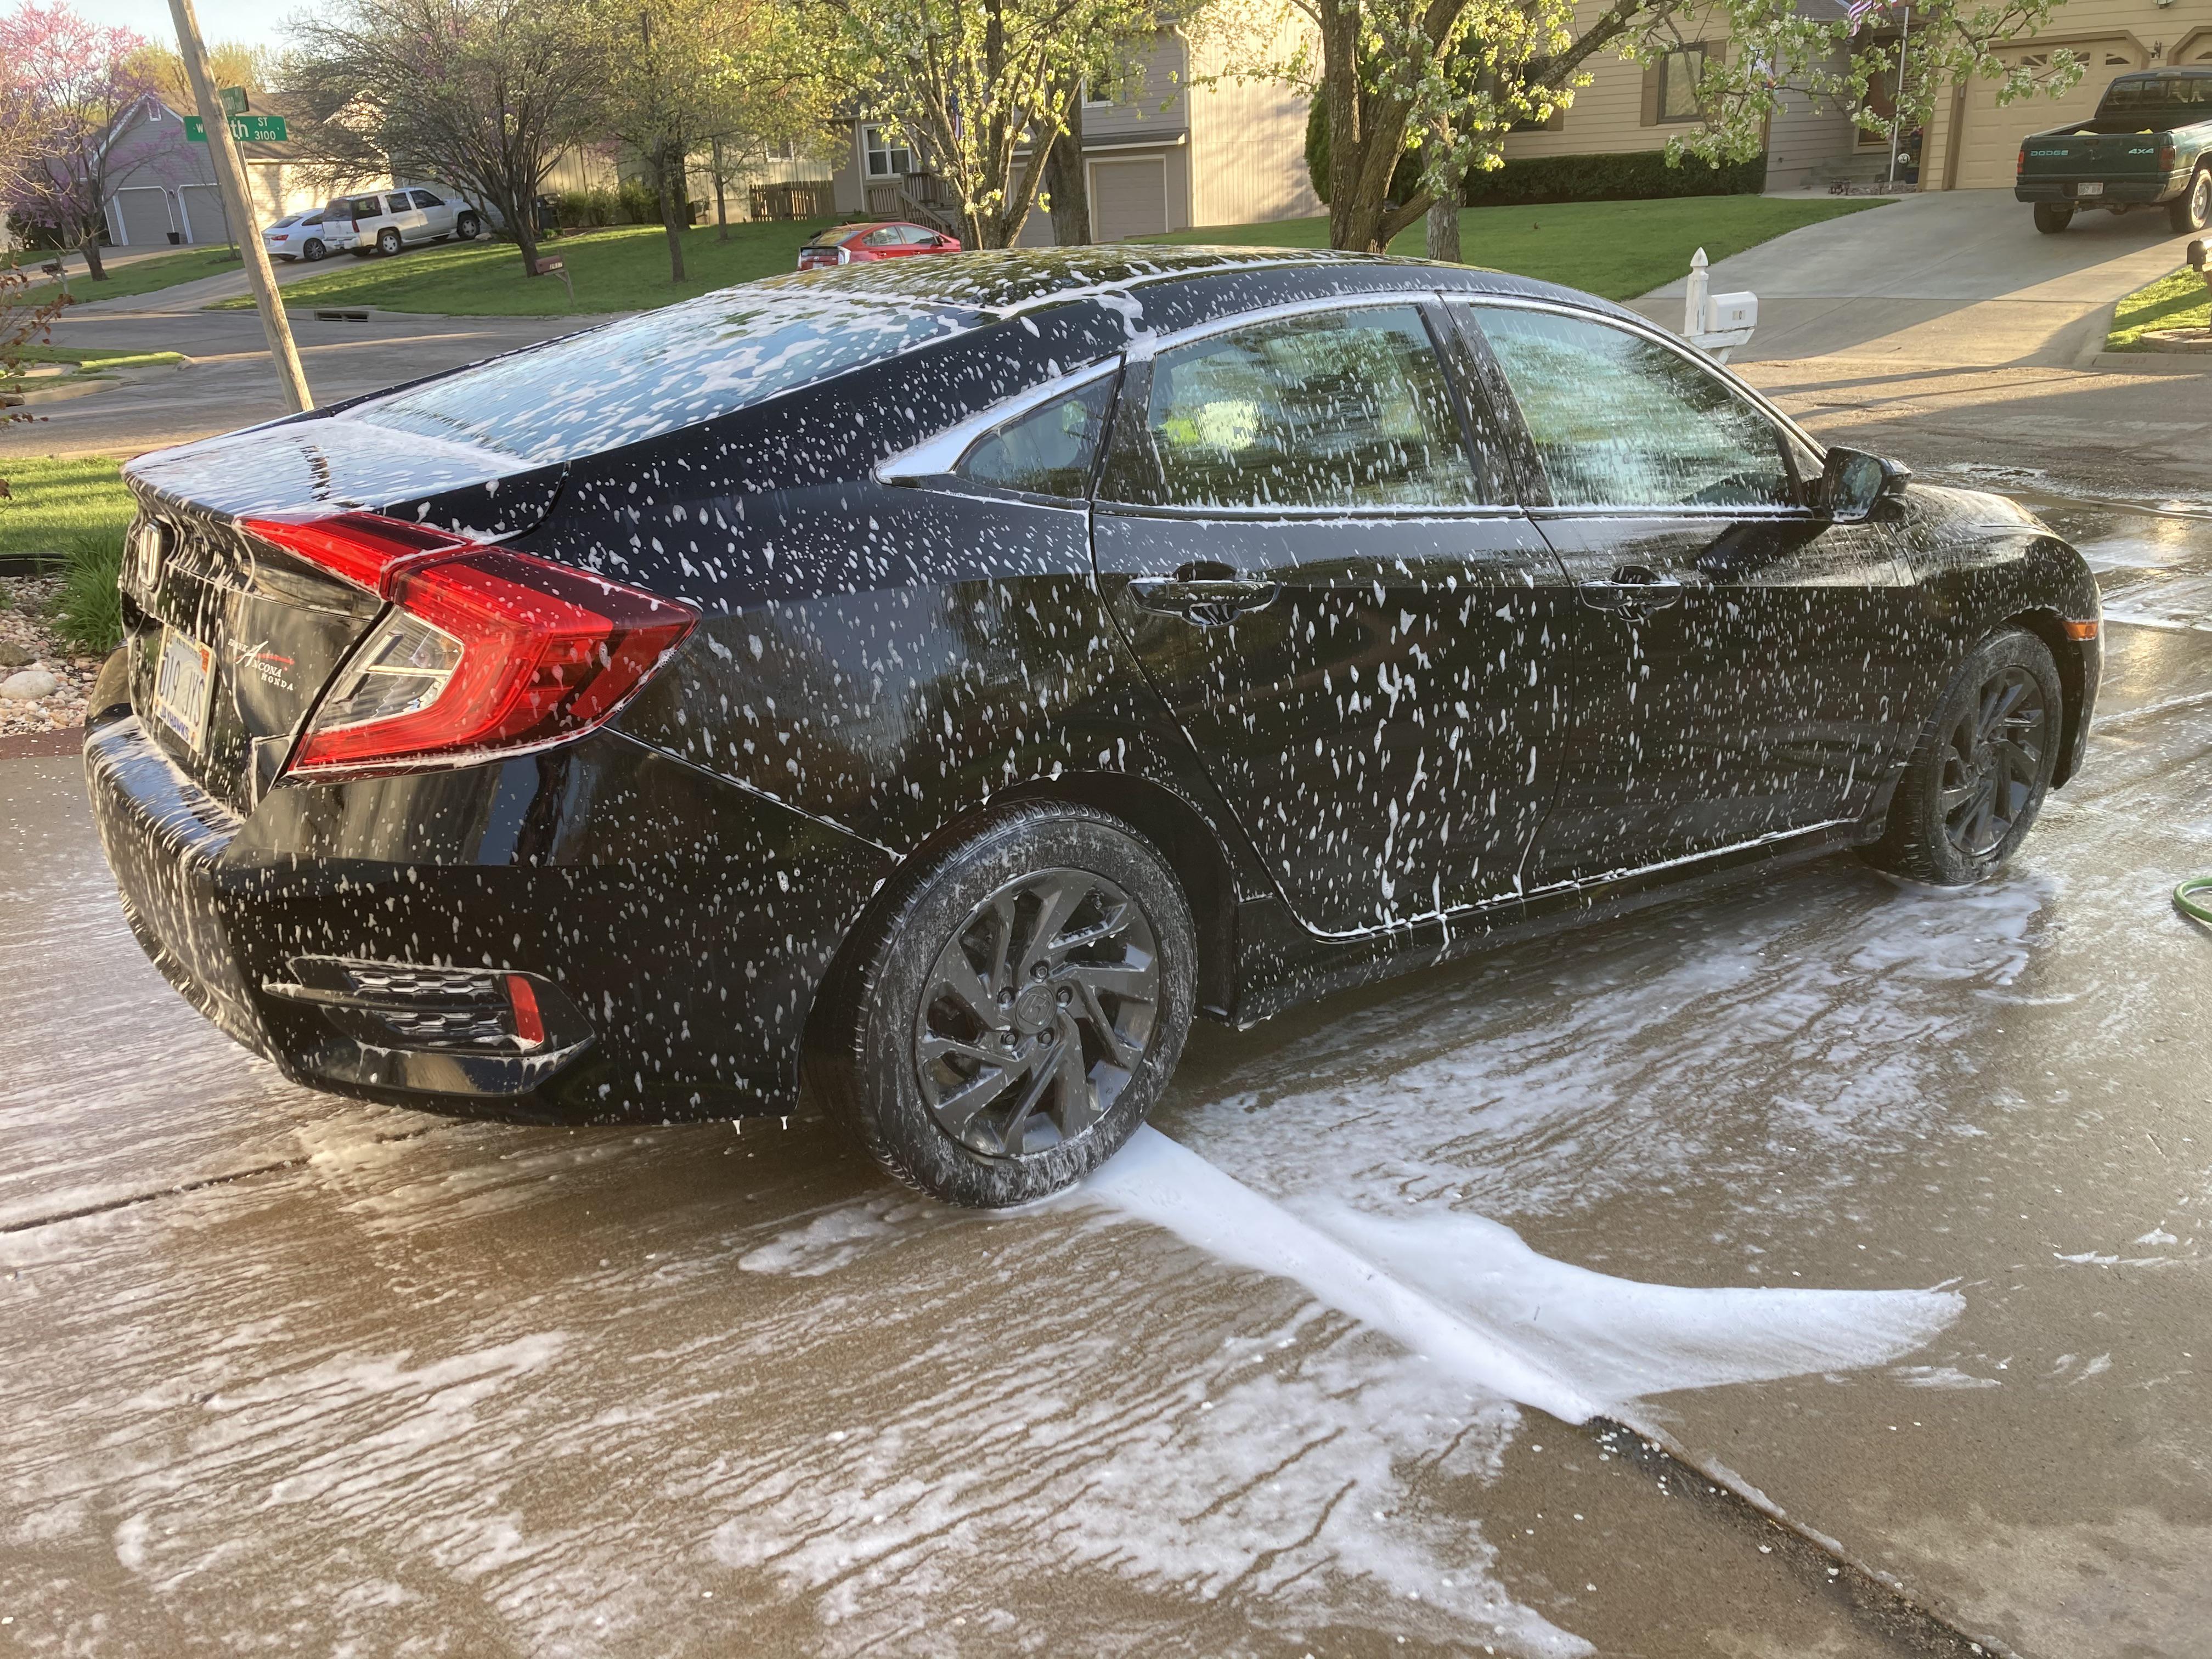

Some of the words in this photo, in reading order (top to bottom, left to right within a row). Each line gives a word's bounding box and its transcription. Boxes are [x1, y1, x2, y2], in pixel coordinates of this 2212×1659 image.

[196, 123, 204, 133] W
[258, 117, 268, 127] ST
[255, 131, 276, 140] 3100
[261, 673, 294, 691] HONDA
